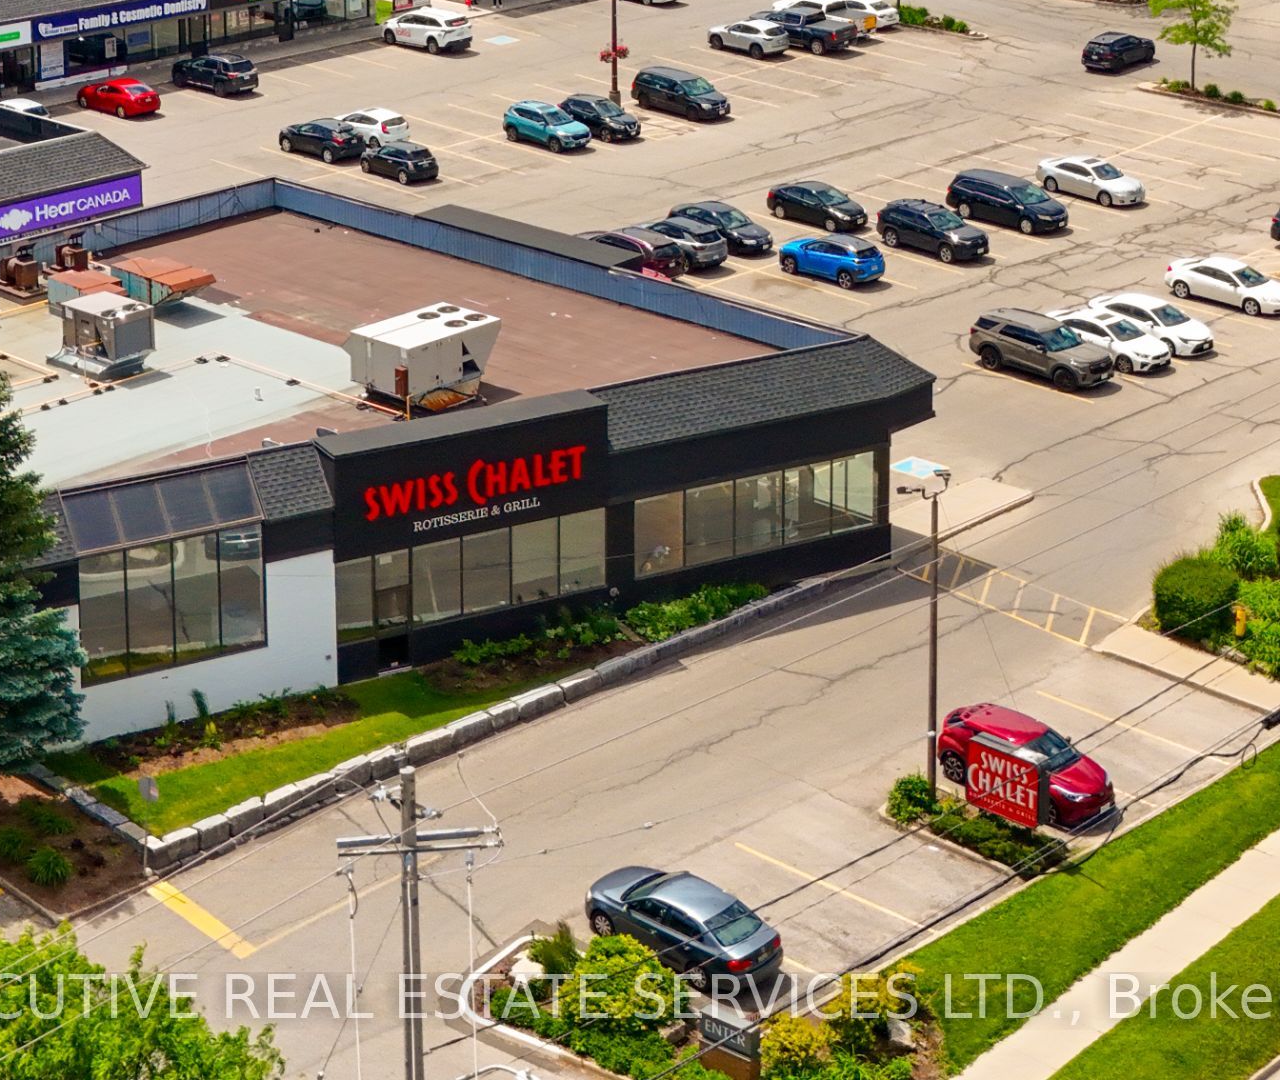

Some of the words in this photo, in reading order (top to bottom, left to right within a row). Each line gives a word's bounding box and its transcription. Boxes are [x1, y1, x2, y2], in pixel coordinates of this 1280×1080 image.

[78, 13, 111, 31] Family
[111, 11, 119, 24] &
[119, 4, 163, 23] Cosmetic
[362, 471, 459, 522] SWISS
[466, 445, 587, 505] CHALET
[412, 506, 489, 533] ROTISSERIE
[490, 504, 501, 517] &
[503, 497, 541, 515] GRILL
[980, 751, 1028, 784] SWISS
[967, 763, 1038, 810] CHALET
[704, 1018, 746, 1048] ENTER
